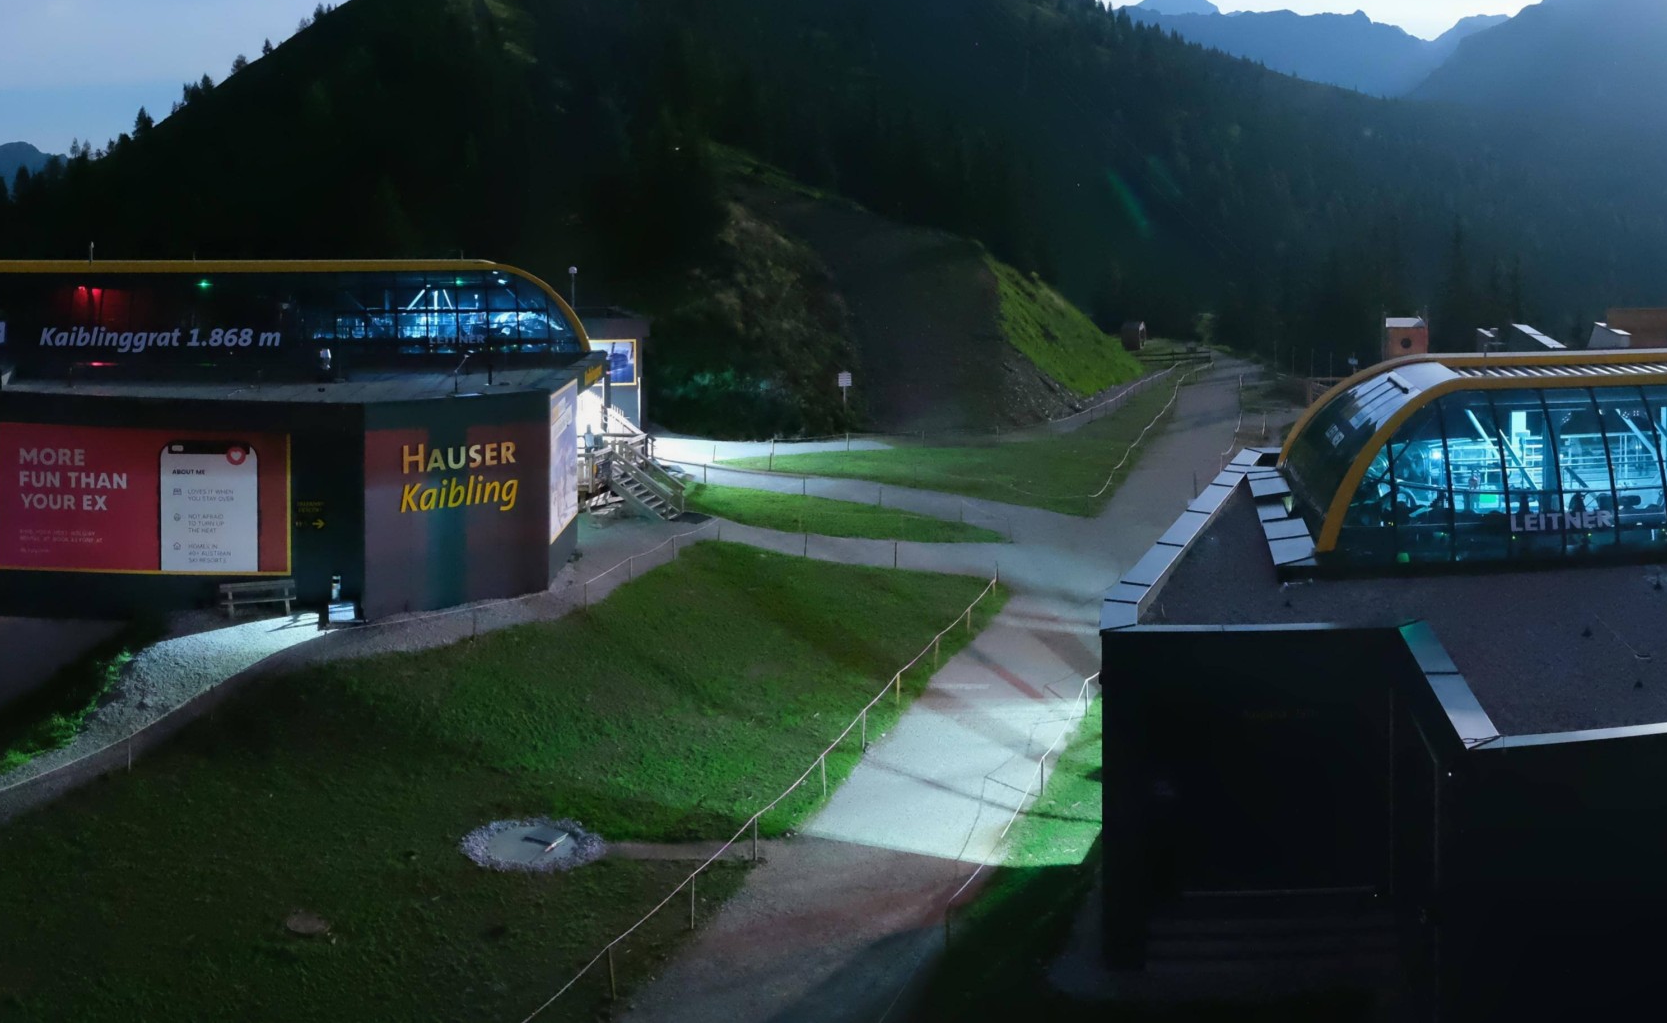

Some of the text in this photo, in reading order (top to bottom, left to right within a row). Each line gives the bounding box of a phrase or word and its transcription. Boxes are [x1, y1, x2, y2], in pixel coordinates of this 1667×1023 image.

[39, 326, 281, 353] Kaiblinggrat 1.868 m
[19, 447, 85, 466] MORE
[402, 441, 517, 474] HAUSER
[19, 471, 128, 490] FUN THAN
[21, 493, 108, 511] YOUR EX
[401, 475, 519, 513] Kaibling
[1510, 510, 1613, 532] LEITNER
